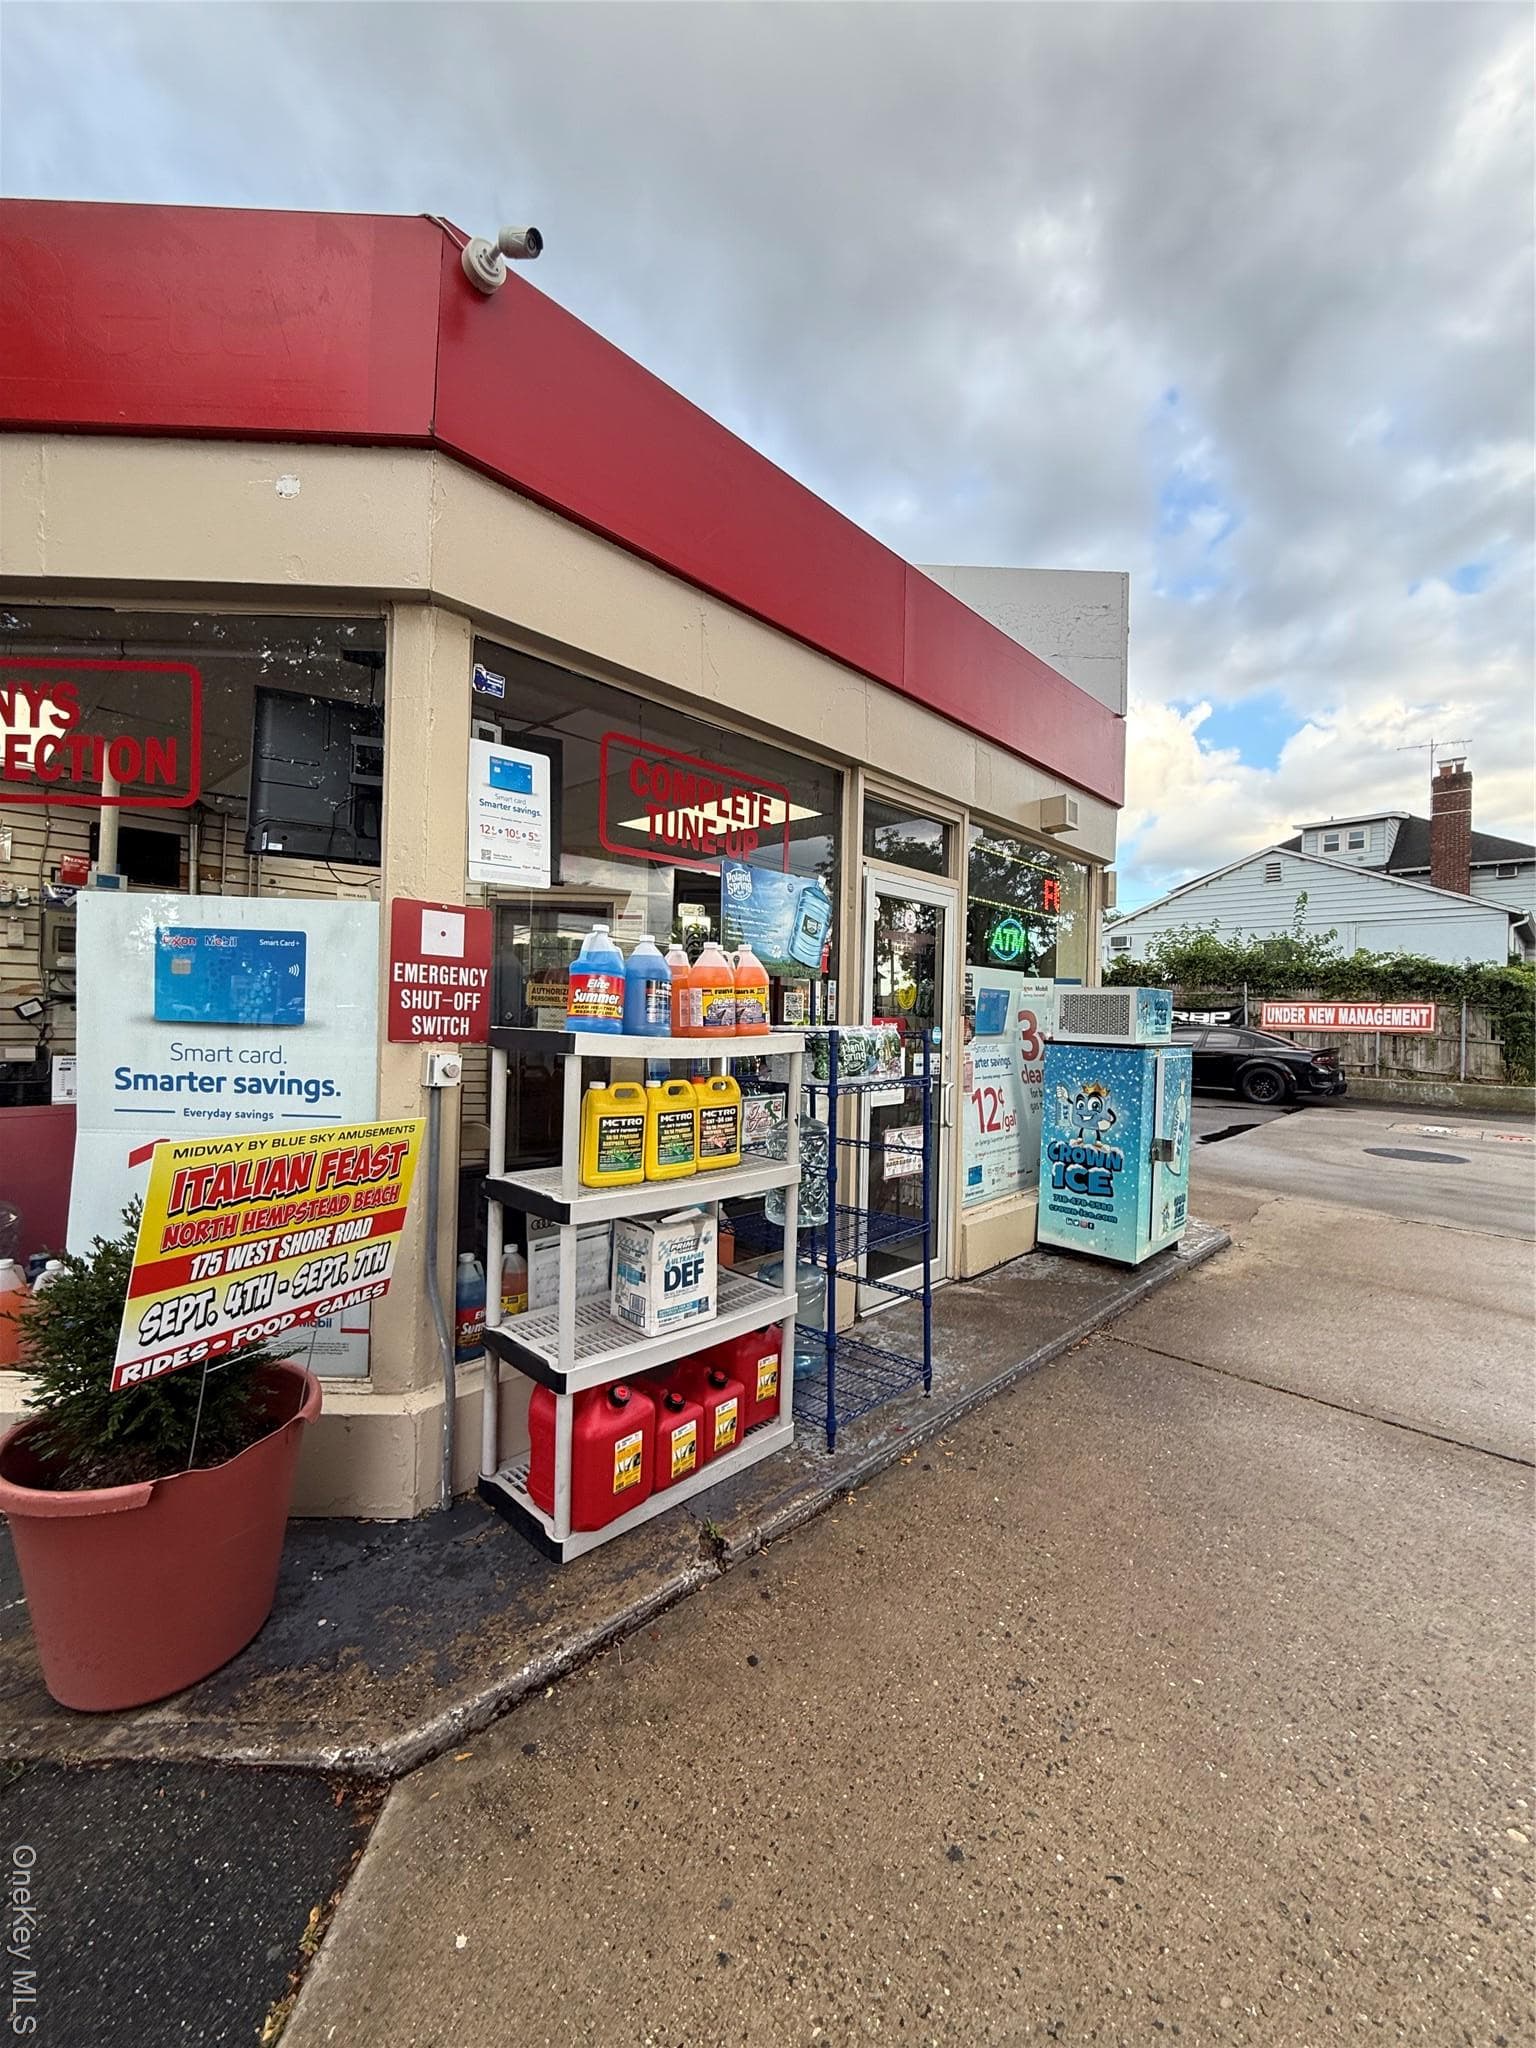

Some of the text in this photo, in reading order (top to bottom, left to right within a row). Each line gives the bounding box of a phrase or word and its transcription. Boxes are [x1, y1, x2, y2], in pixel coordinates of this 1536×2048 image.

[0, 681, 80, 730] NYS
[629, 757, 773, 830] COMPLETE
[480, 798, 542, 817] Smarter savings.
[644, 803, 758, 861] TUNE-UP
[726, 870, 751, 883] Poland
[728, 880, 752, 895] Spring
[204, 935, 238, 948] Mobil
[259, 938, 279, 947] Smart
[991, 927, 1025, 952] ATM
[393, 962, 488, 987] EMERGENCY
[587, 977, 610, 990] Elite
[400, 988, 481, 1011] SHUT-OFF
[531, 986, 568, 995] AUTHORIZ
[573, 988, 620, 1005] Summer
[411, 1015, 470, 1036] SWITCH
[1172, 1011, 1231, 1024] RBP
[1267, 1006, 1429, 1026] UNDER NEW MANAGEMENT
[170, 1042, 288, 1065] Smart card.
[115, 1067, 342, 1103] Smarter savings.
[183, 1108, 274, 1121] Everyday savings
[173, 1125, 416, 1159] MIDWAY BY BLUE SKY AMUSEMENTS
[1047, 1141, 1124, 1172] CROWN
[168, 1151, 316, 1217] ITALIAN
[316, 1140, 410, 1191] FEAST
[1052, 1162, 1114, 1197] ICE
[161, 1183, 401, 1250] NORTH HEMPSTEAD BEACH
[190, 1216, 373, 1281] 175 WEST SHORE ROAD
[671, 1251, 705, 1265] ULTRAPURE
[663, 1258, 705, 1293] DEF
[139, 1287, 219, 1346] SEPT.
[224, 1272, 277, 1319] 4TH
[291, 1253, 348, 1299] SEPT.
[351, 1241, 392, 1282] 7TH
[119, 1283, 386, 1387] RIDES FOOD GAMES
